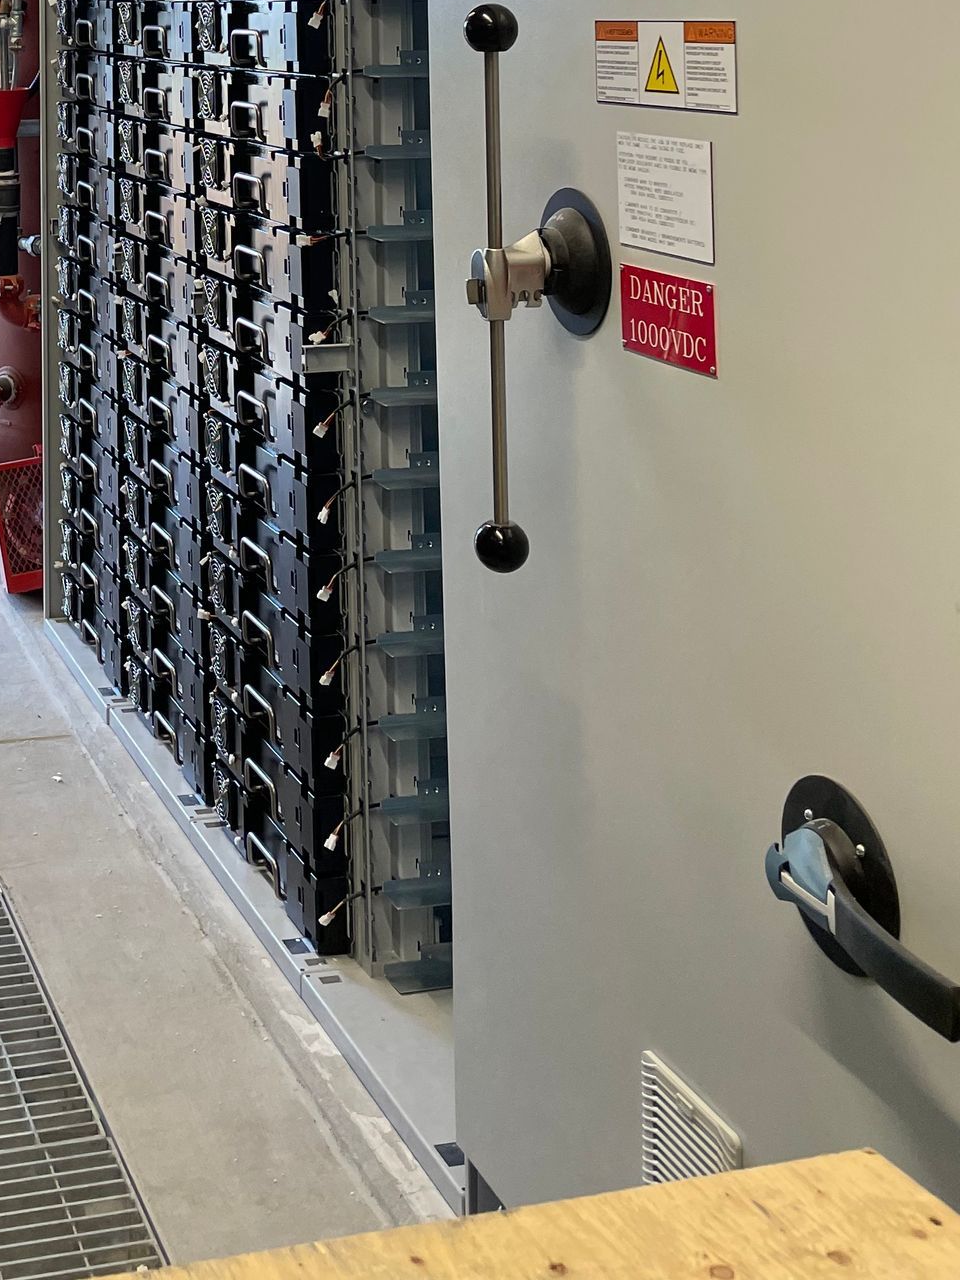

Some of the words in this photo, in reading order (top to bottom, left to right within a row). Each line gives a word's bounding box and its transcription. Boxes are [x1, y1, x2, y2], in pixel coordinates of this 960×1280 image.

[697, 27, 734, 40] WARNING
[630, 275, 704, 317] DANGER
[630, 318, 707, 362] 1000VDC
